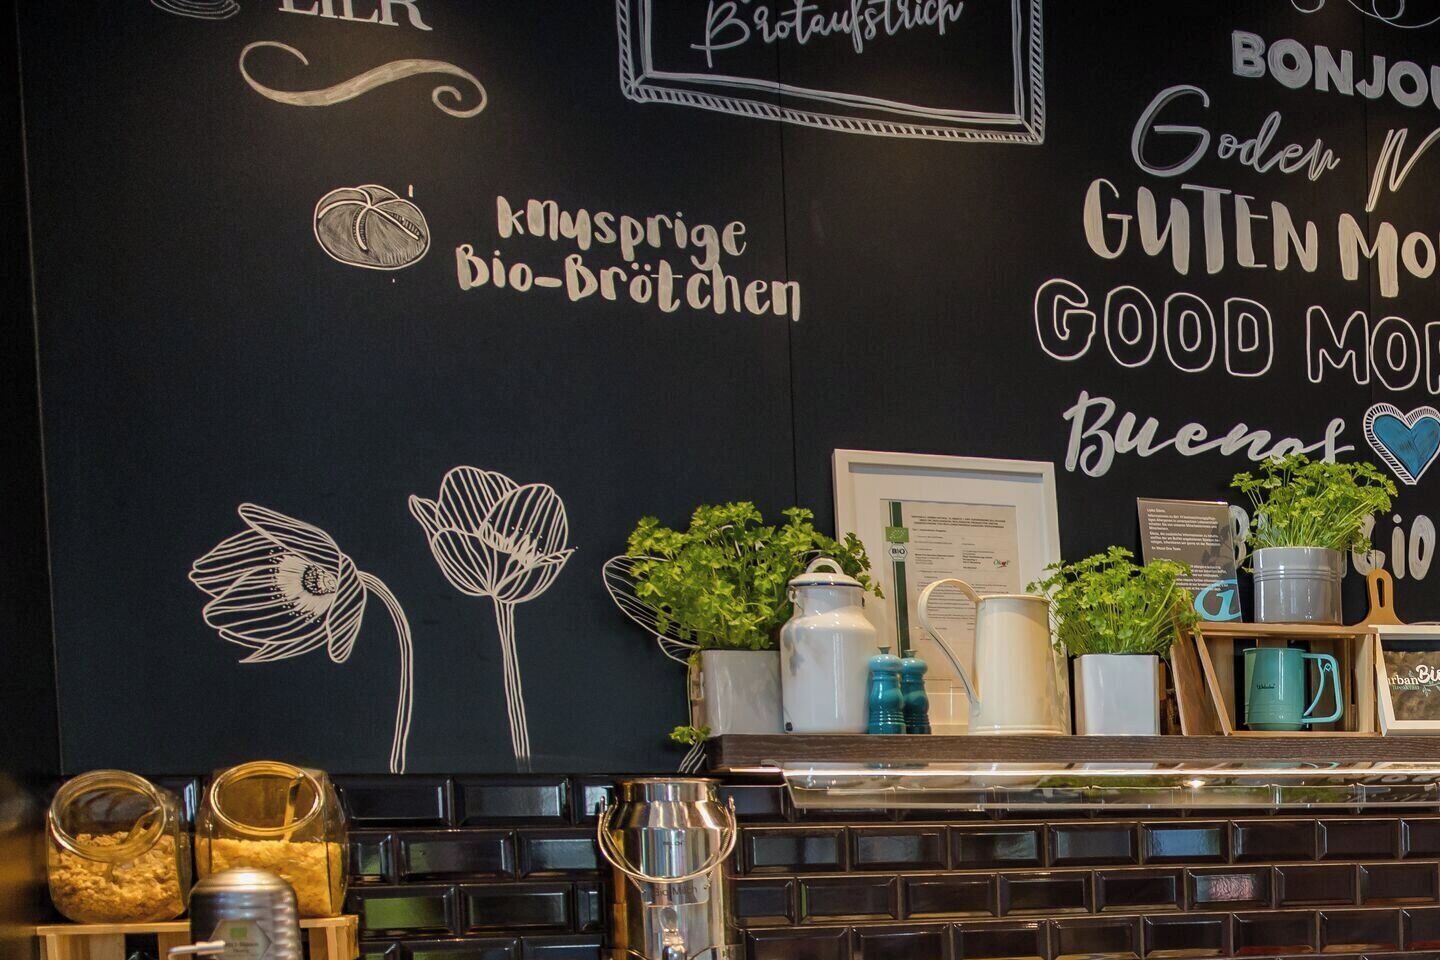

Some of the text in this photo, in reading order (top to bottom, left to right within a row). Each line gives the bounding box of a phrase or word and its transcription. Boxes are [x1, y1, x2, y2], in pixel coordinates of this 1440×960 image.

[1083, 178, 1318, 275] GUTEN
[456, 244, 800, 322] Bio-Brötchen
[1034, 278, 1274, 377] GOOD
[1063, 390, 1355, 477] Buenos
